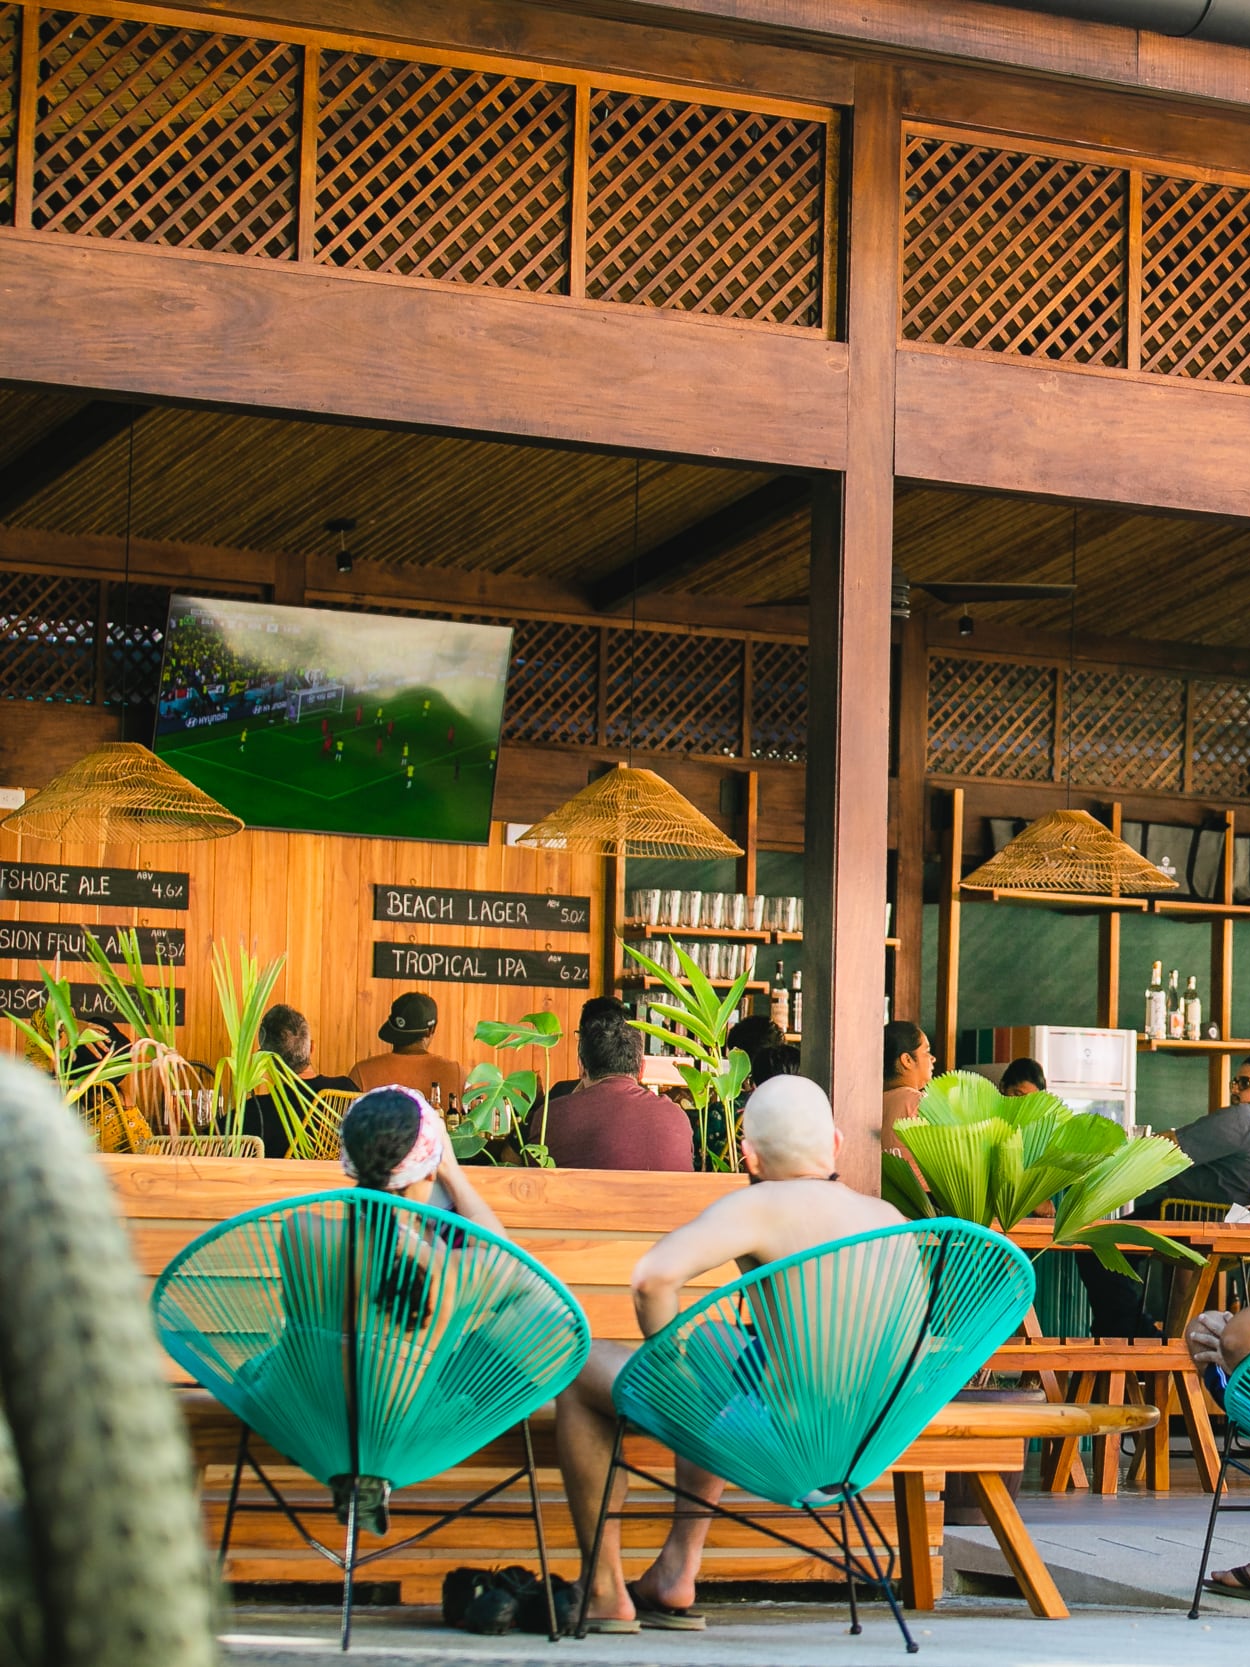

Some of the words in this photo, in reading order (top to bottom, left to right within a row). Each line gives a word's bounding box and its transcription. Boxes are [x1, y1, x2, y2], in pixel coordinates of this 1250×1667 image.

[0, 868, 70, 894] FSHORE
[78, 875, 111, 896] ALE
[136, 871, 154, 881] ABV
[152, 882, 184, 899] 4.6%
[386, 891, 454, 919] BEACH
[468, 898, 530, 924] LAGER
[0, 928, 42, 951] SION
[392, 949, 487, 977] TROPICAL
[497, 957, 528, 979] IPA
[560, 965, 589, 981] 6.2%
